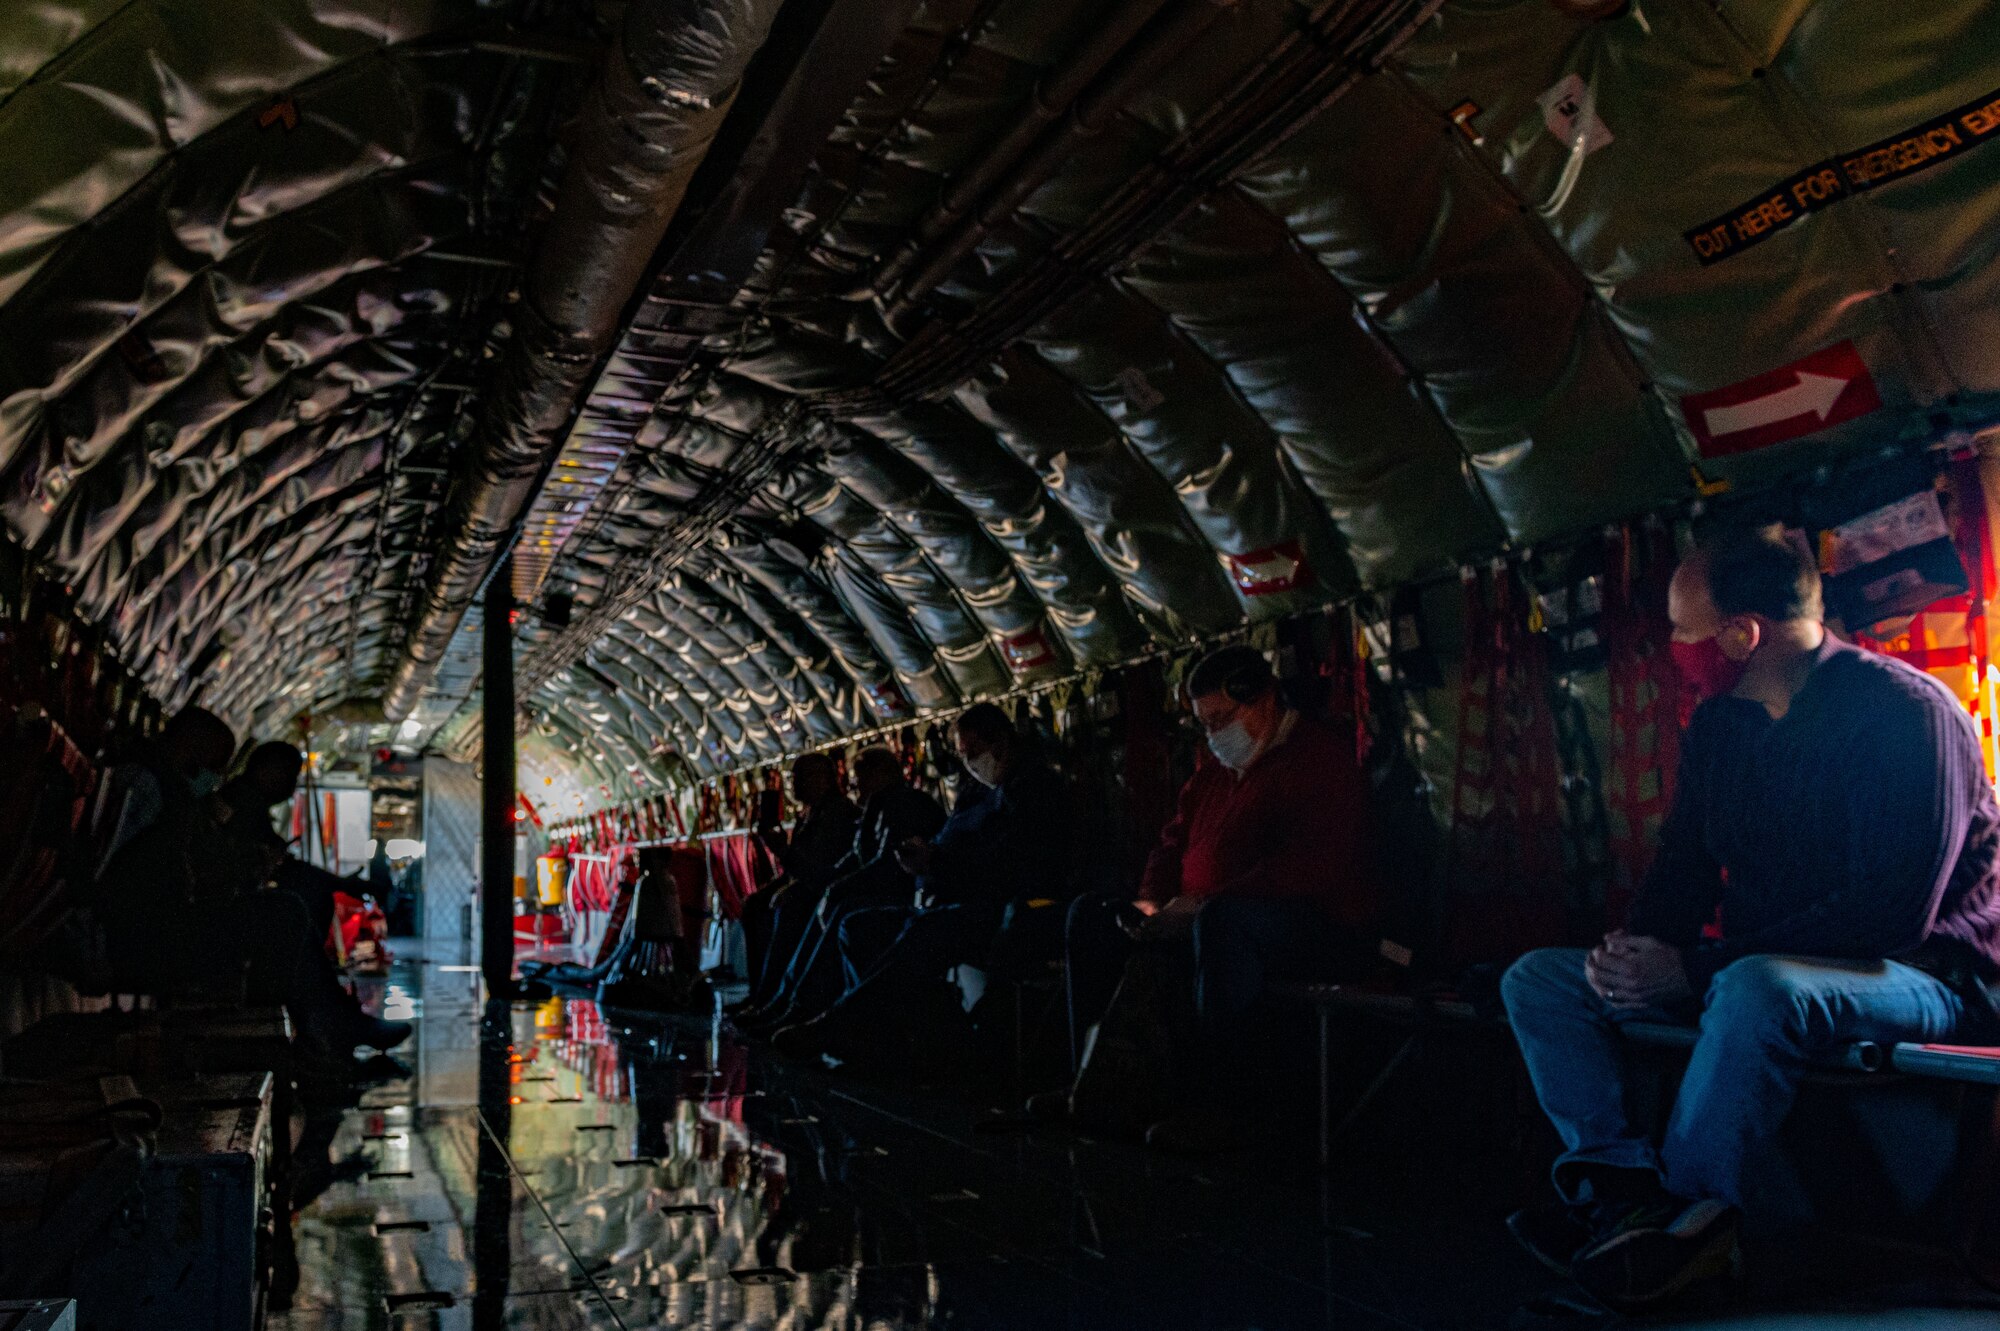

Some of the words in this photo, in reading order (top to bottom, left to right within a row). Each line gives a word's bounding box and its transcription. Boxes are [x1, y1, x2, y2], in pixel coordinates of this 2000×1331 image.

[1692, 224, 1732, 257] CUT
[1731, 193, 1793, 241] HERE
[1791, 169, 1841, 208] FOR
[1842, 122, 1963, 186] EMERGENCY
